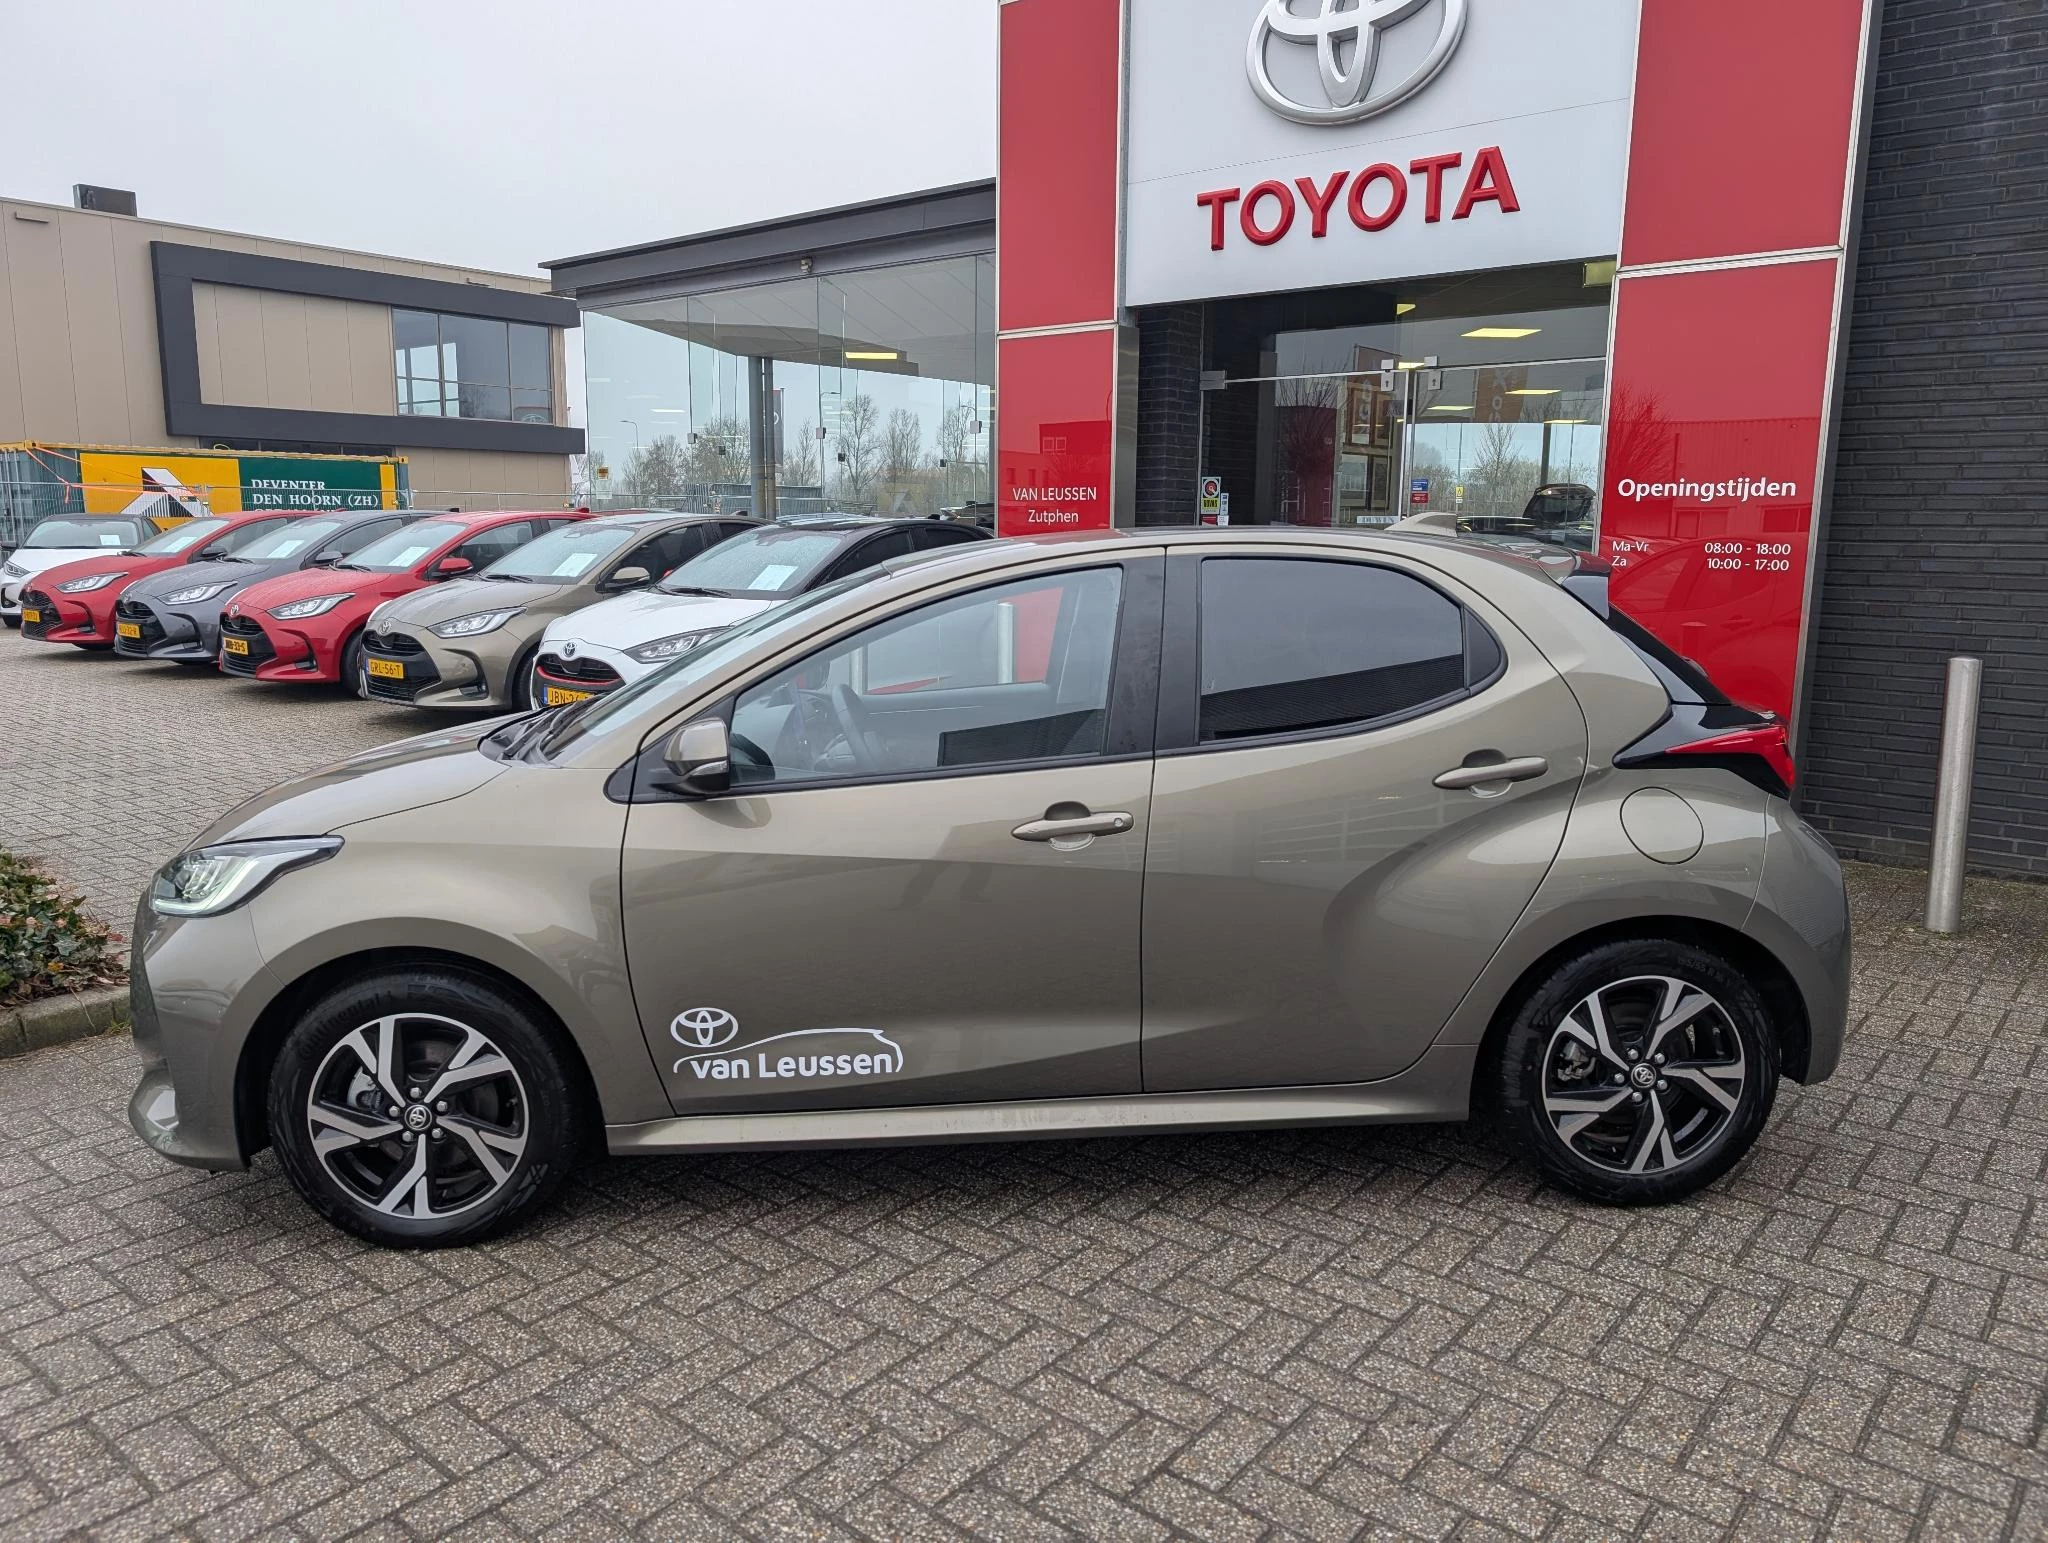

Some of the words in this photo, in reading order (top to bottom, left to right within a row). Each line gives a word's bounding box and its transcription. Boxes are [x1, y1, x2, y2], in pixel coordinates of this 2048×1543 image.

[1197, 146, 1520, 251] TOYOTA
[251, 479, 325, 490] DEVENTER
[1617, 477, 1796, 502] Openingstijden
[252, 493, 283, 505] DEN
[289, 494, 342, 506] HOORN
[347, 494, 379, 507] (ZH)
[1012, 487, 1038, 501] VAN
[1041, 486, 1097, 501] LEUSSEN
[1028, 508, 1079, 525] Zutphen
[1612, 540, 1650, 552] Ma-Vr
[1704, 542, 1743, 554] 08:00
[1755, 543, 1792, 555] 18:00
[1611, 555, 1627, 567] Za
[1707, 558, 1742, 570] 10:00
[1755, 559, 1790, 571] 17:00
[690, 1058, 750, 1080] van
[758, 1053, 893, 1078] Leussen
